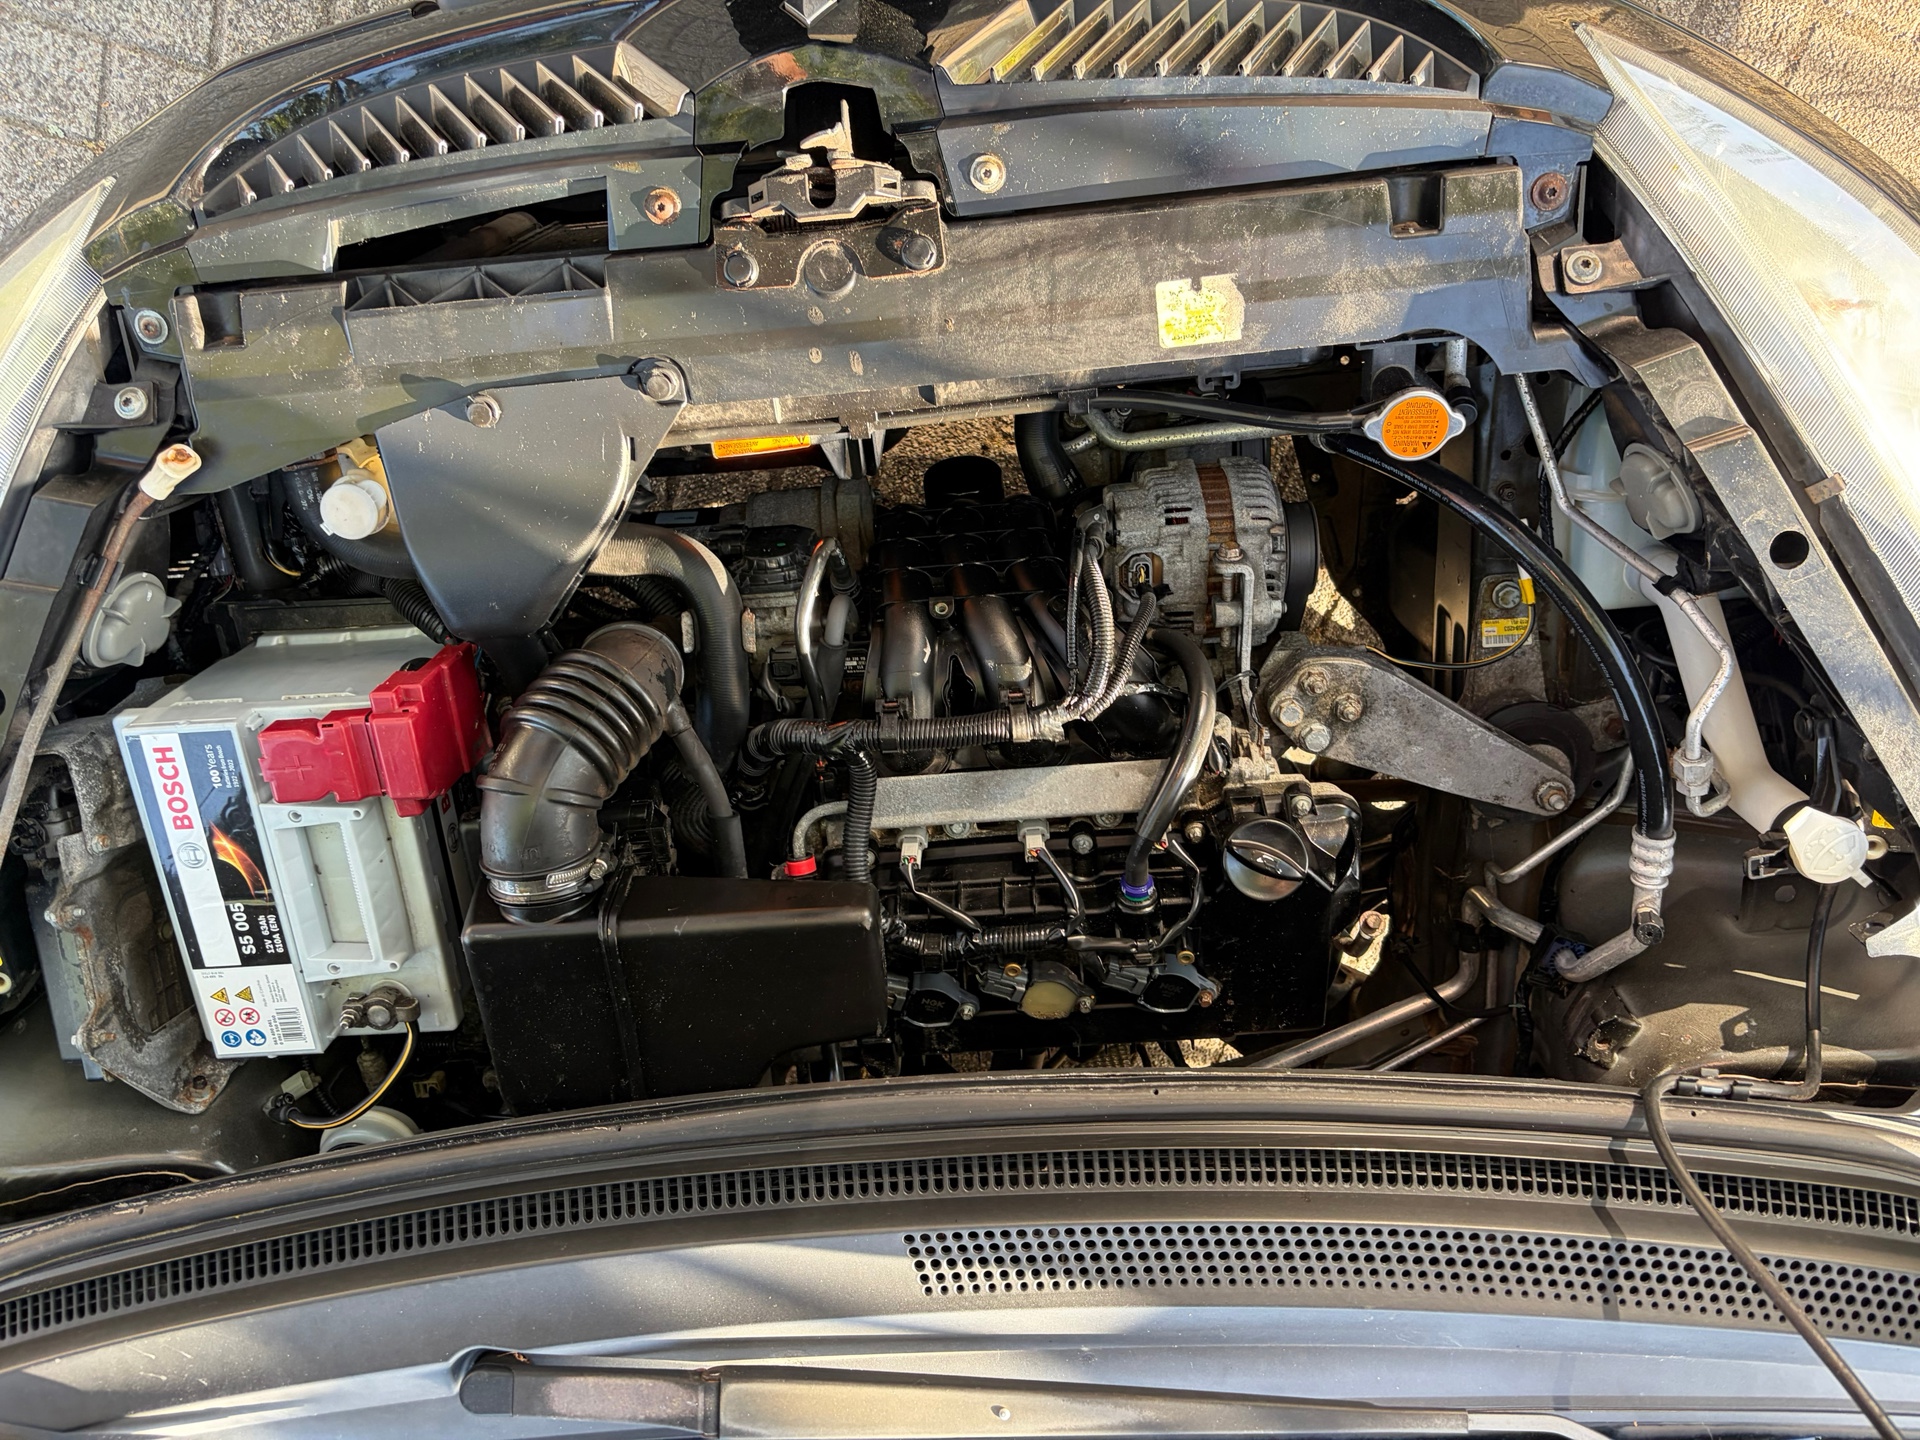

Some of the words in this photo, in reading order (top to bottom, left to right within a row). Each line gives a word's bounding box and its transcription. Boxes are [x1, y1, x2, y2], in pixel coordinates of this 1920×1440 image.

[204, 743, 218, 771] Years
[215, 744, 225, 760] Bosch
[219, 759, 228, 771] from
[152, 747, 194, 830] BOSCH
[209, 769, 223, 789] 100
[222, 769, 232, 789] Batteries
[230, 902, 250, 932] 005
[258, 915, 270, 936] 63Ah
[267, 914, 280, 932] (EN)
[238, 935, 257, 955] S5
[264, 939, 275, 954] 12V
[272, 933, 285, 953] 610A
[1160, 983, 1183, 993] NGK
[921, 998, 946, 1009] NGK
